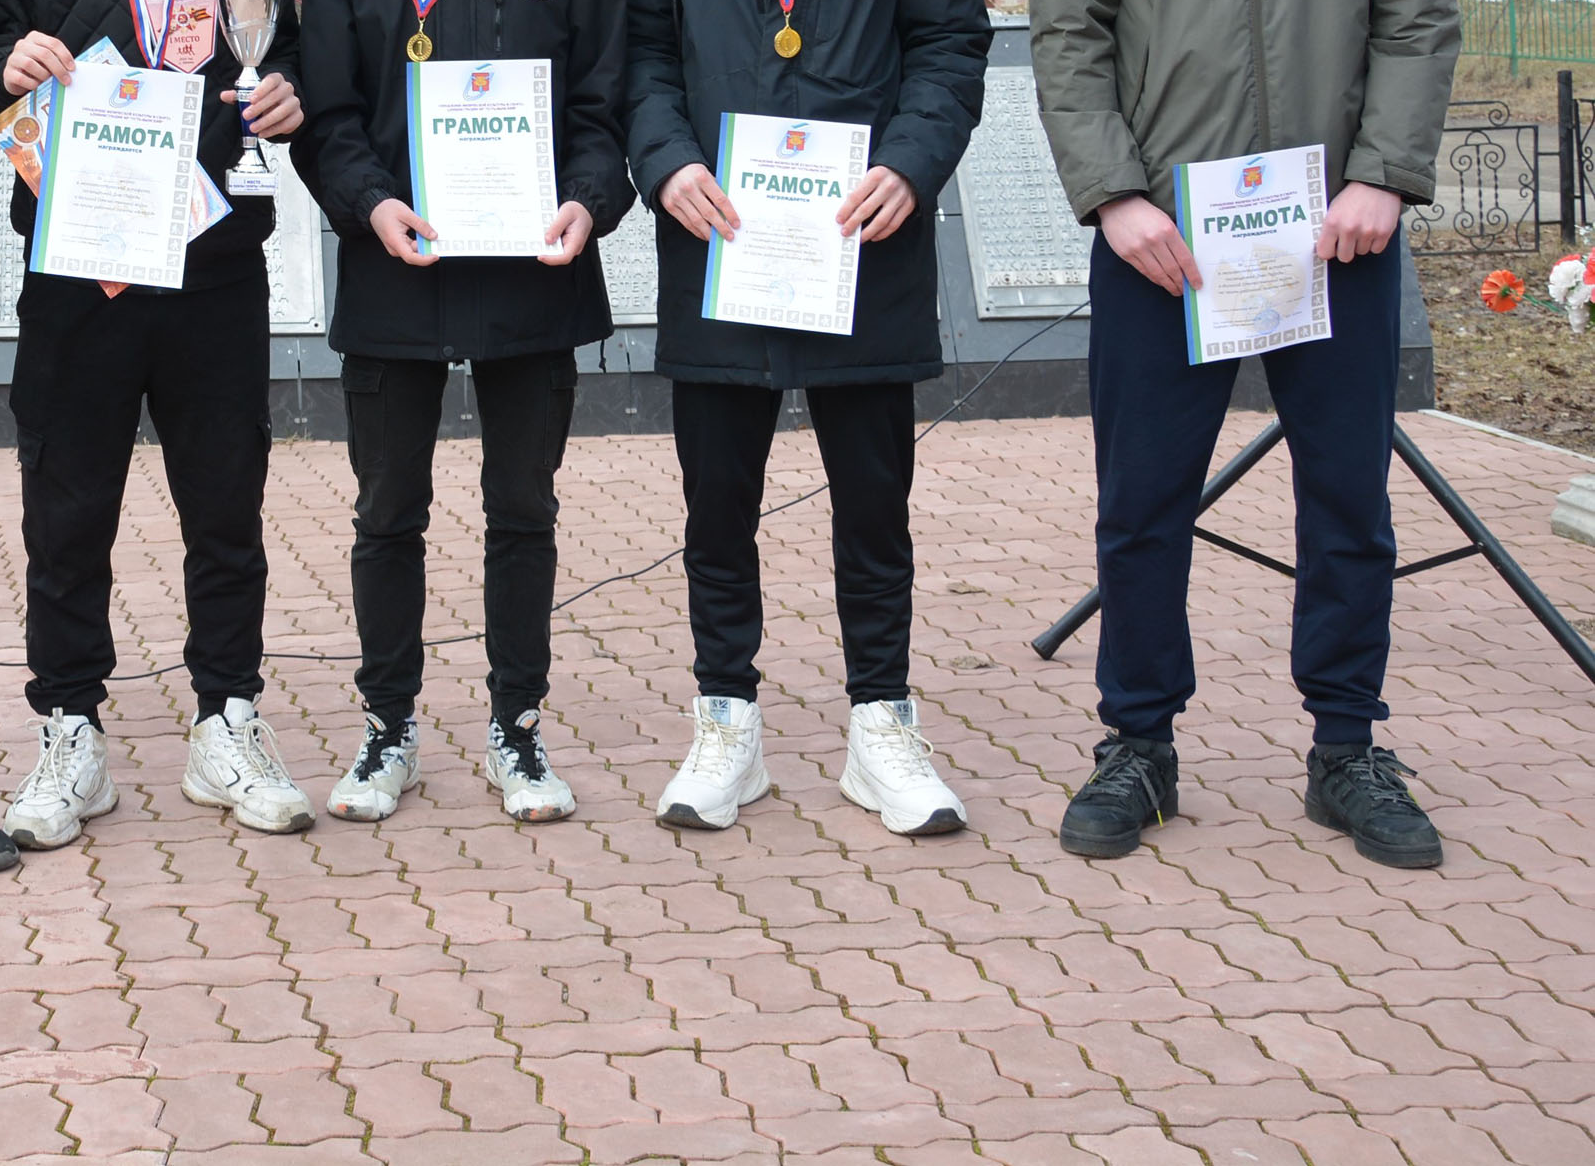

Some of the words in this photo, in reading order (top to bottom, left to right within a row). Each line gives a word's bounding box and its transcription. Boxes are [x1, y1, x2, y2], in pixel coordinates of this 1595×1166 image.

[72, 121, 175, 150] ГРАМОТА
[432, 116, 531, 135] ГРАМОТА
[741, 171, 842, 198] ГРАМОТА
[1204, 204, 1307, 234] ГРАМОТА
[989, 272, 1056, 285] ИСАКОВ
